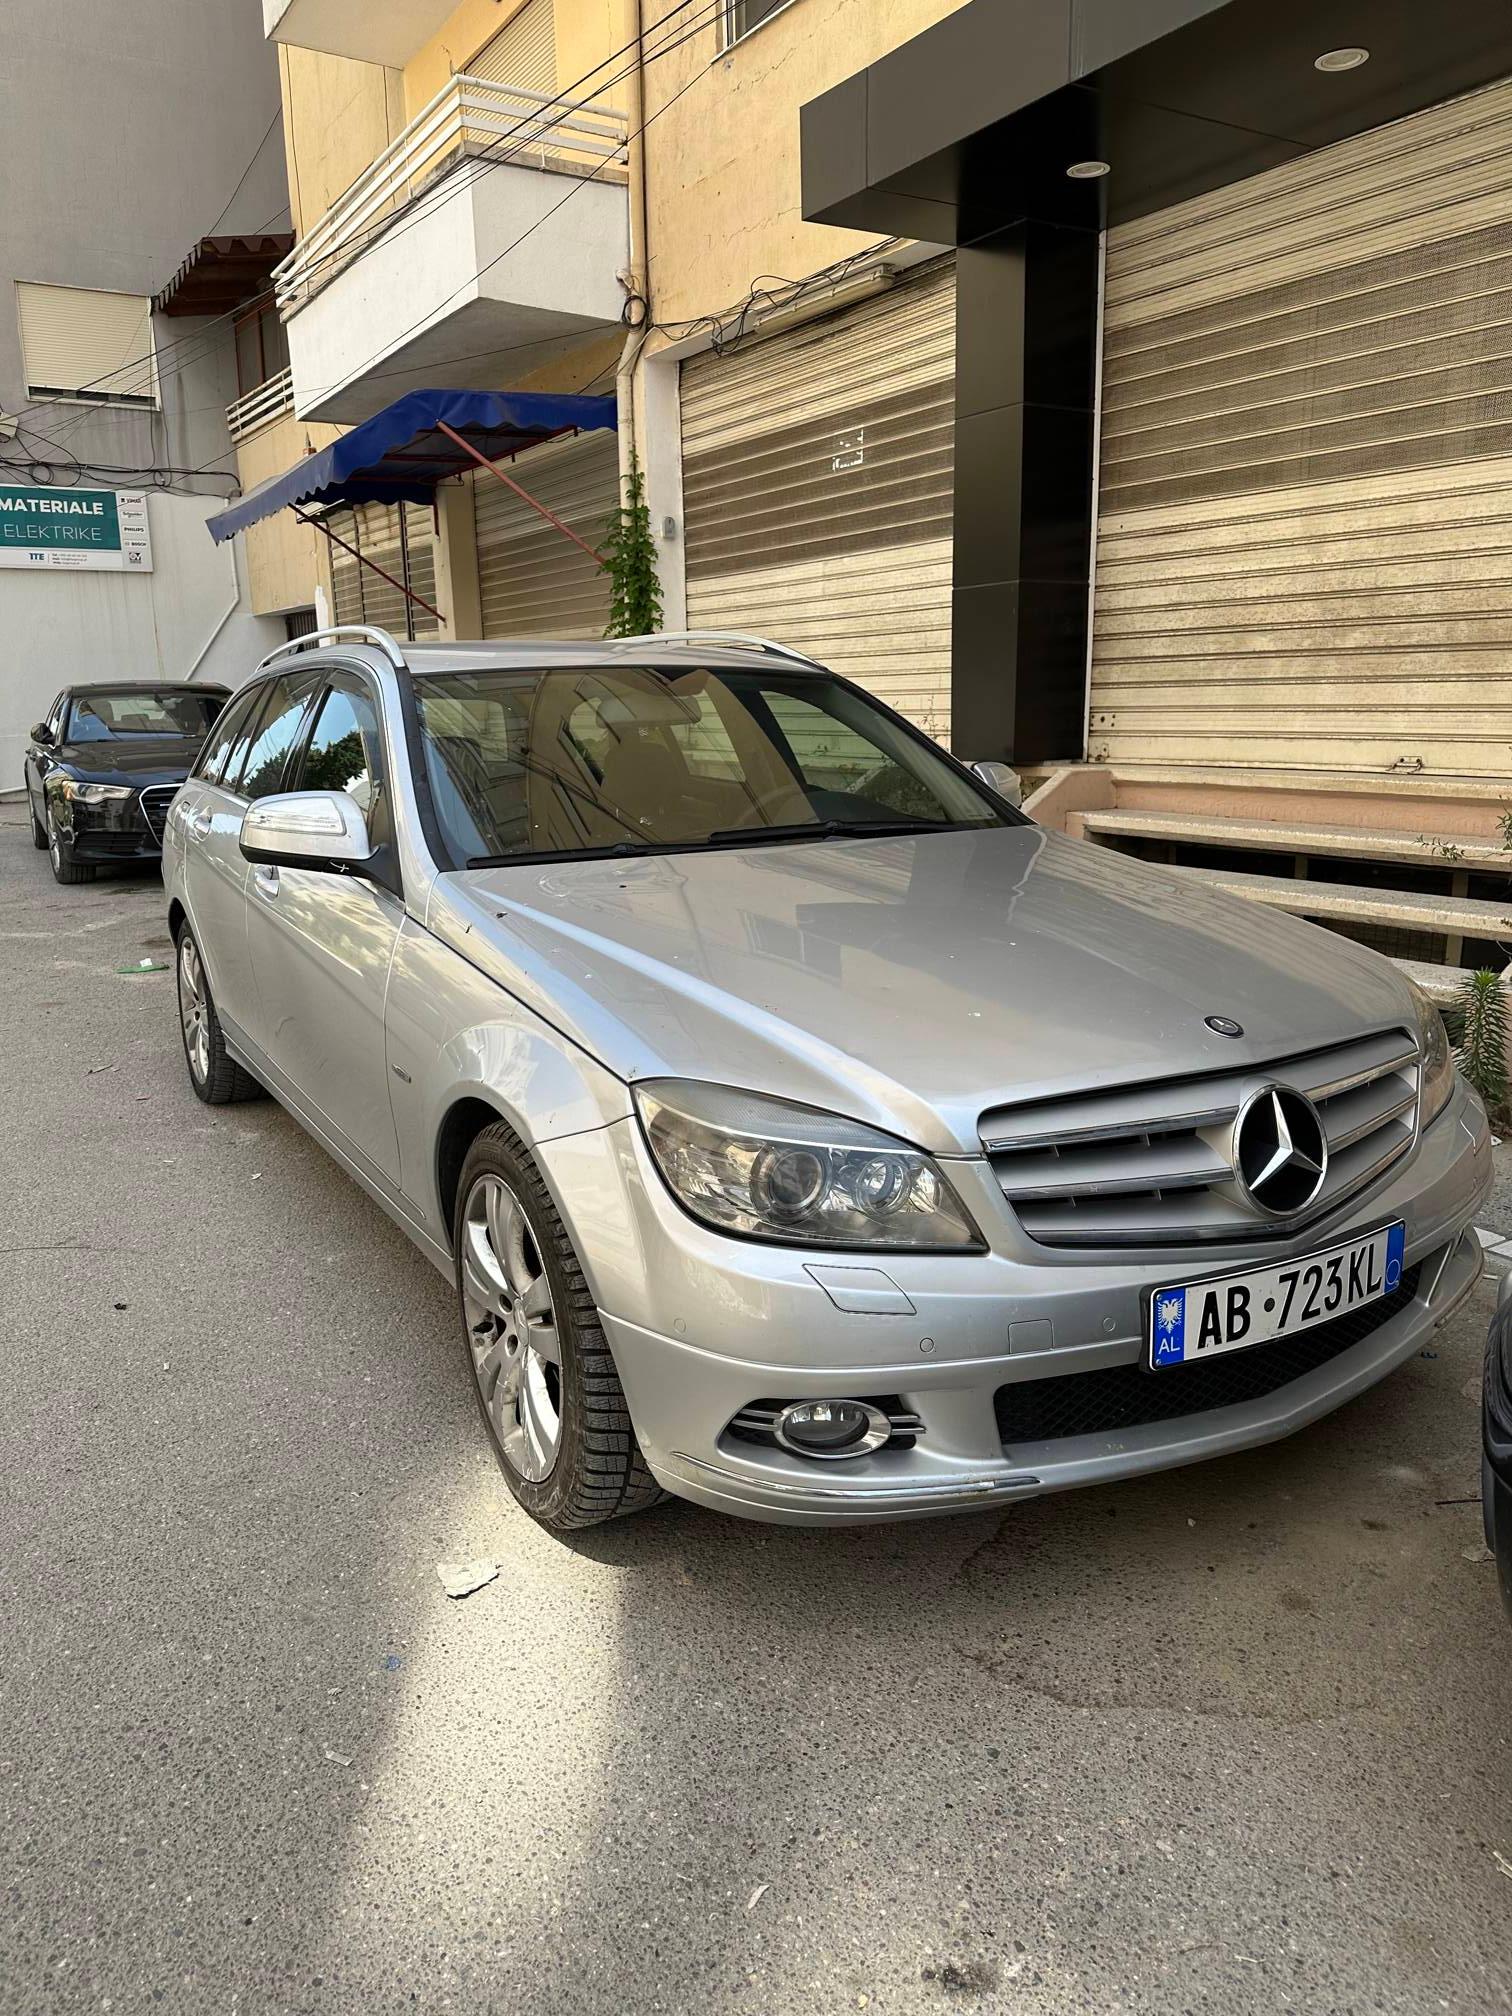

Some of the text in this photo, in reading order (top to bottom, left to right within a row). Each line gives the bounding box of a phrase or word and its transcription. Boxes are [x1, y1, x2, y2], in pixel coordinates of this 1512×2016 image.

[0, 498, 104, 516] MATERIALE
[4, 524, 102, 541] ELEKTRIKE
[1197, 1285, 1251, 1350] AB
[1158, 1337, 1180, 1355] AL
